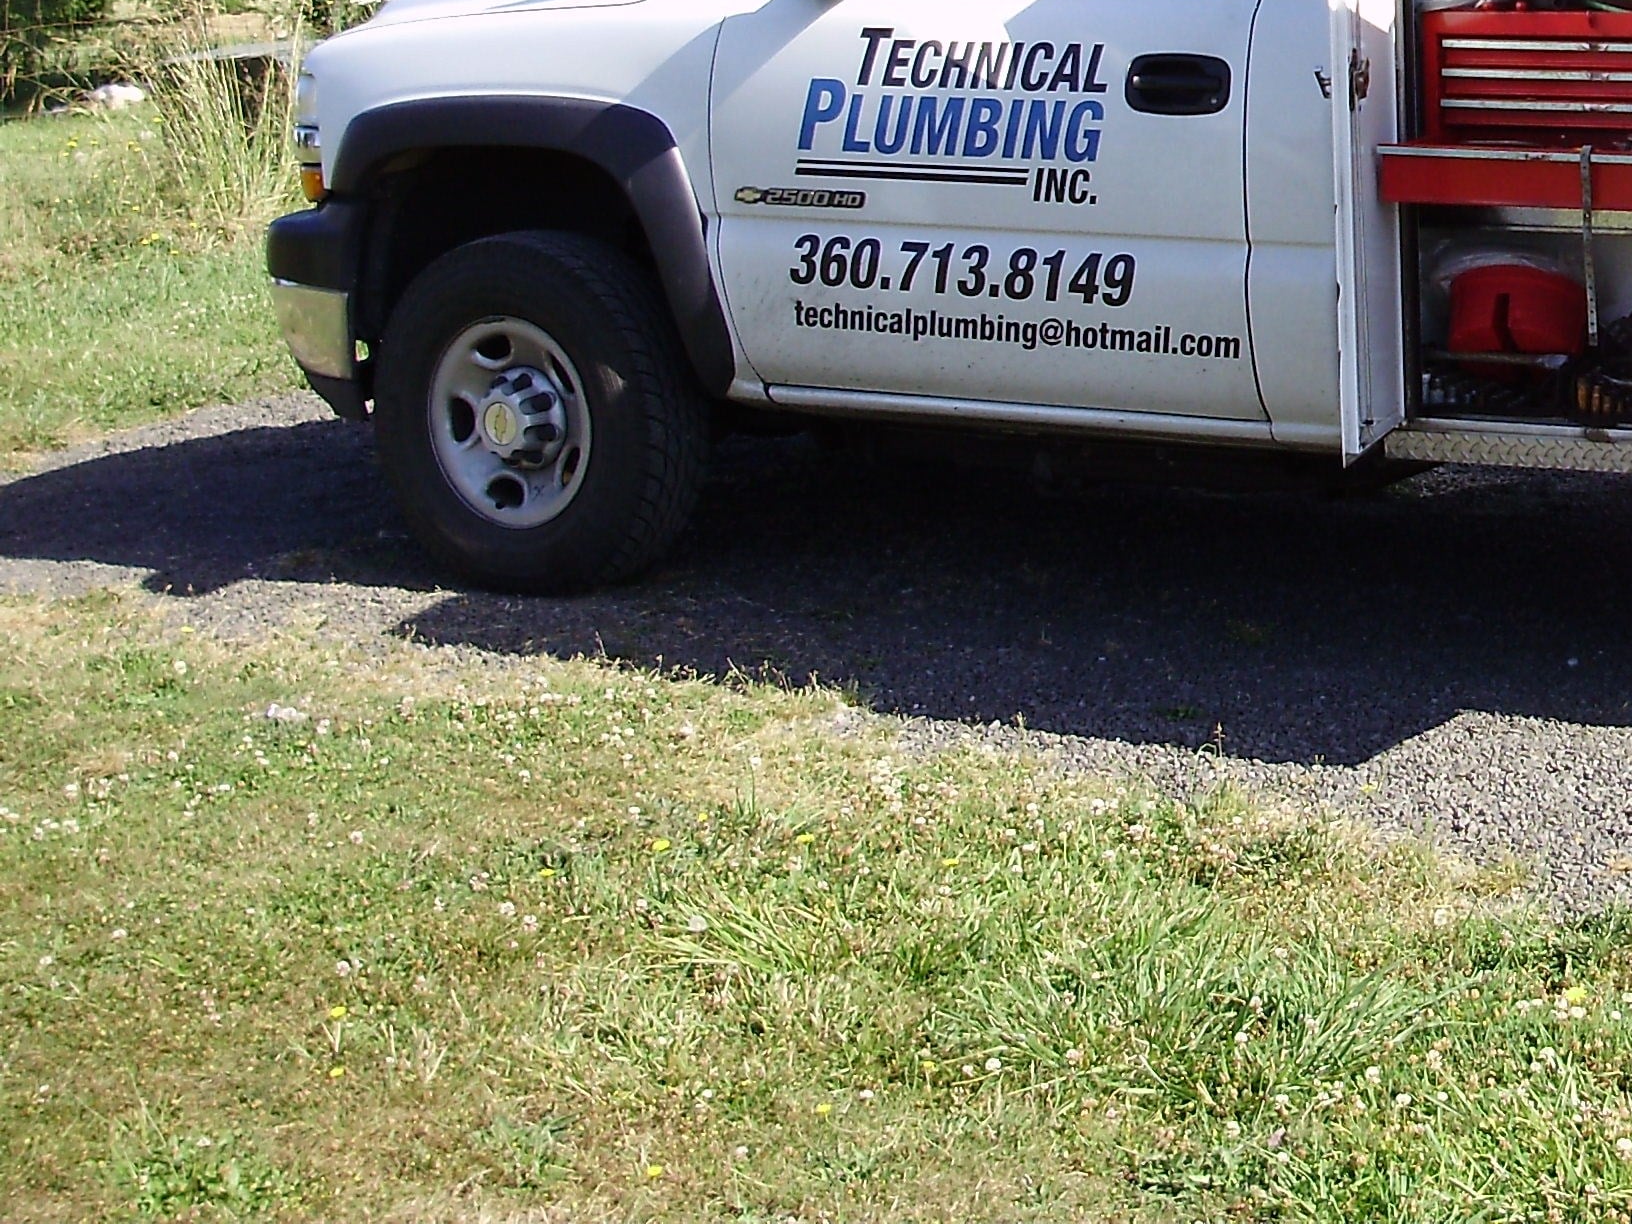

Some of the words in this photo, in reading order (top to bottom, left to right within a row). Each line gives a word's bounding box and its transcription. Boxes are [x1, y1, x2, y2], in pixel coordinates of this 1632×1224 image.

[860, 27, 1108, 93] TECHNICAL
[797, 78, 1104, 162] PLUMBING
[765, 189, 830, 206] 2500
[833, 193, 861, 207] HD
[1032, 168, 1098, 205] INC.
[789, 233, 1136, 307] 360.713.8149
[795, 301, 1241, 359] technicalplumbing@hotmail.com
